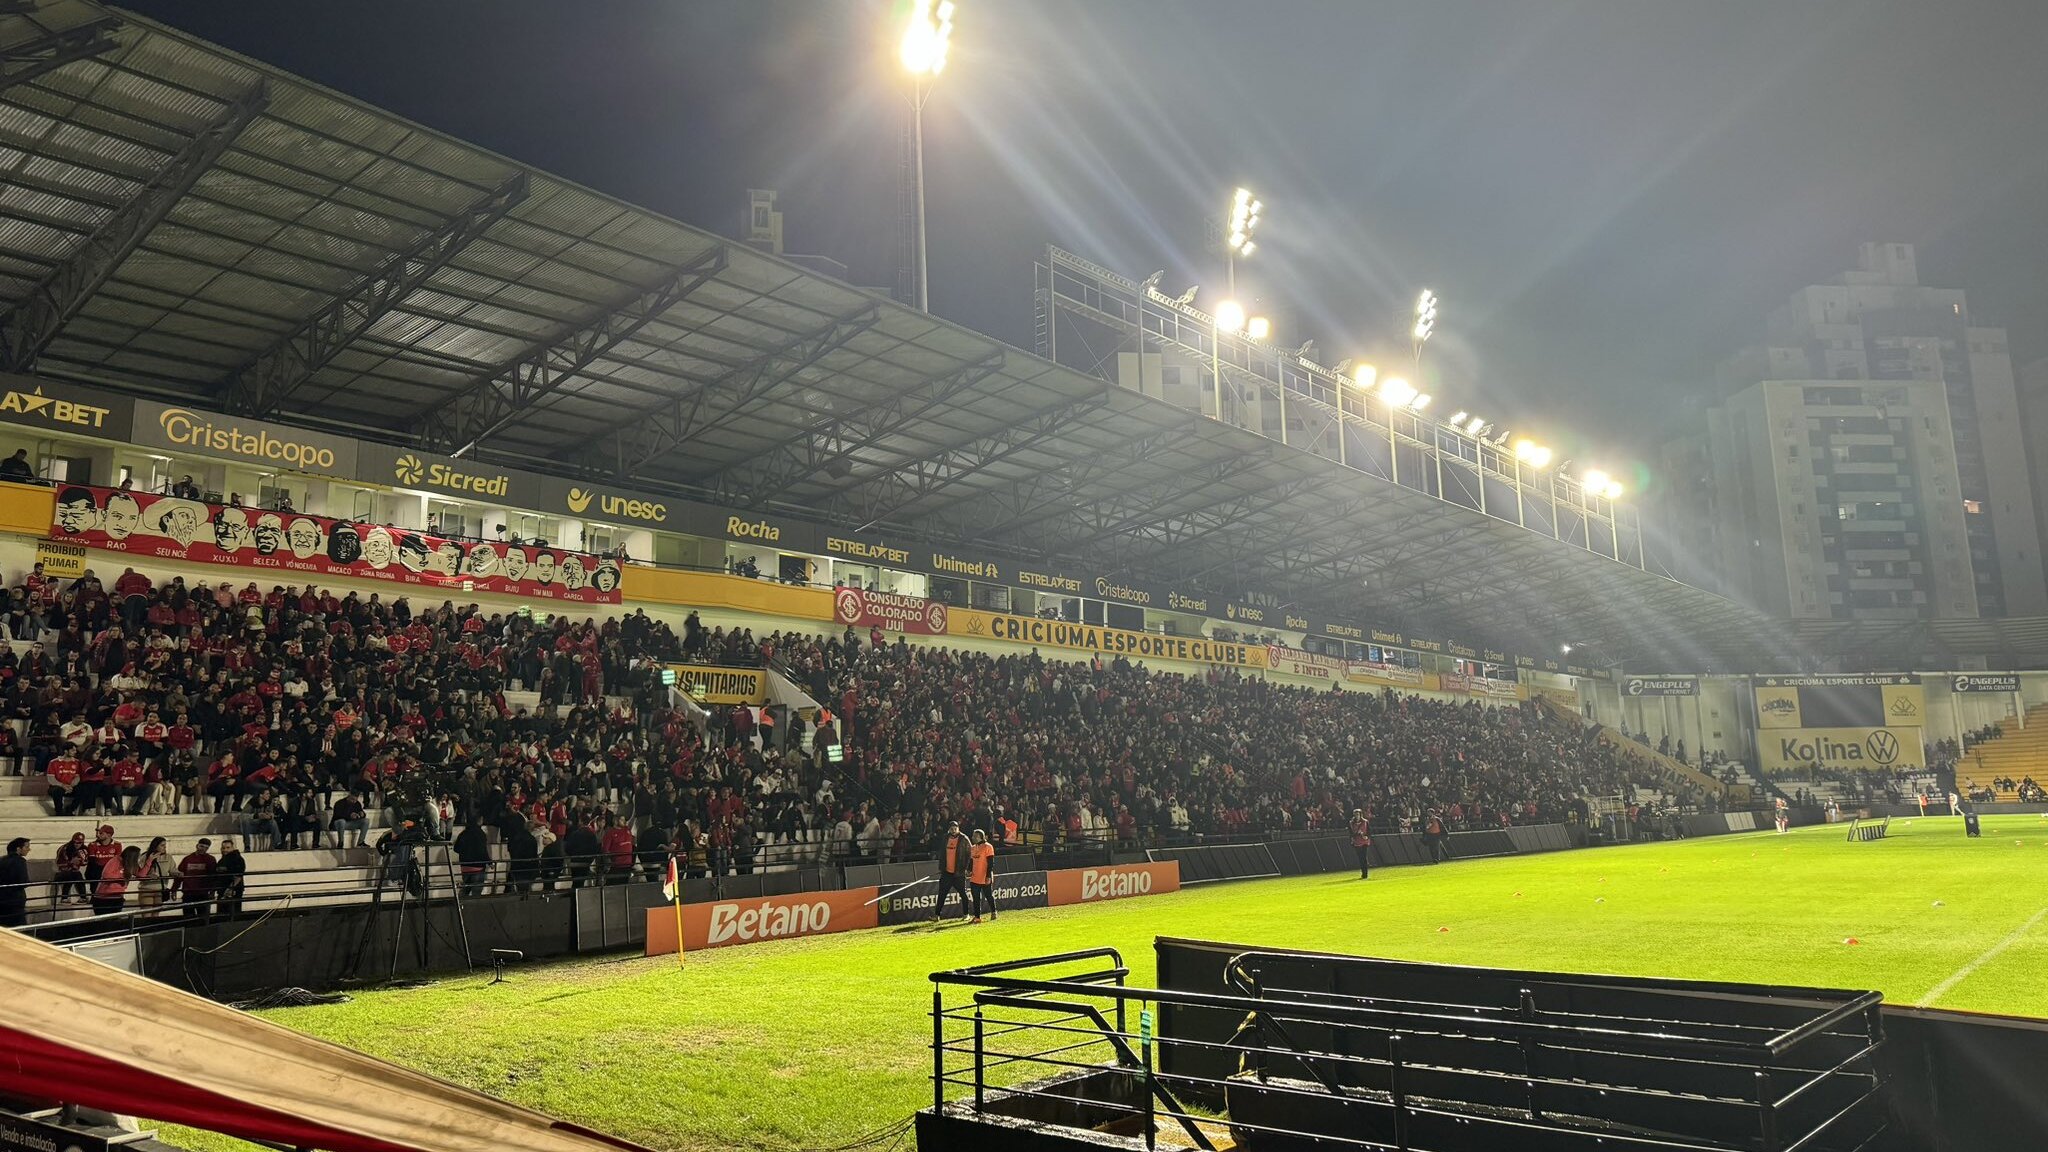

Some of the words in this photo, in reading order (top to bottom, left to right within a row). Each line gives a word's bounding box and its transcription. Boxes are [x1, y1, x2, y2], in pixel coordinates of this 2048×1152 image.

[163, 411, 335, 468] Cristalcopo
[427, 463, 509, 497] Sicredi
[601, 495, 667, 522] unesc
[727, 516, 780, 541] Rocha
[38, 543, 86, 557] PROIBIDO
[106, 540, 127, 551] RAO
[155, 547, 171, 557] SEU
[43, 556, 79, 569] FUMAR
[212, 553, 239, 564] XUXU
[253, 557, 281, 567] BELEZA
[933, 554, 983, 577] Unimed
[294, 561, 318, 571] NOEMIA
[327, 565, 352, 575] MACACO
[375, 570, 396, 580] REGINA
[404, 574, 421, 584] BIRA
[1096, 578, 1150, 604] Cristalcopo
[862, 591, 925, 610] CONSULADO
[1179, 595, 1207, 612] Sicredi
[866, 604, 922, 622] COLORADO
[1238, 605, 1264, 622] unesc
[885, 619, 904, 632] IJUÍ
[1286, 615, 1308, 629] Rocha
[991, 617, 1099, 649] CRICIÚMA
[1103, 631, 1188, 659] ESPORTE
[1191, 642, 1247, 664] CLUBE
[1371, 629, 1396, 643] Unimed
[1302, 664, 1330, 679] INTER
[1644, 681, 1691, 689] ENGEPLUS
[1783, 678, 1825, 686] CRICIÚMA
[1827, 678, 1864, 686] ESPORTE
[1866, 677, 1893, 685] CLUBE
[1970, 677, 2016, 685] ENGEPLUS
[1781, 737, 1863, 762] Kolina
[1021, 884, 1048, 898] 2024
[1081, 869, 1152, 900] Betano
[707, 901, 831, 944] Betano
[0, 1123, 20, 1143] Venda
[20, 1133, 25, 1145] e
